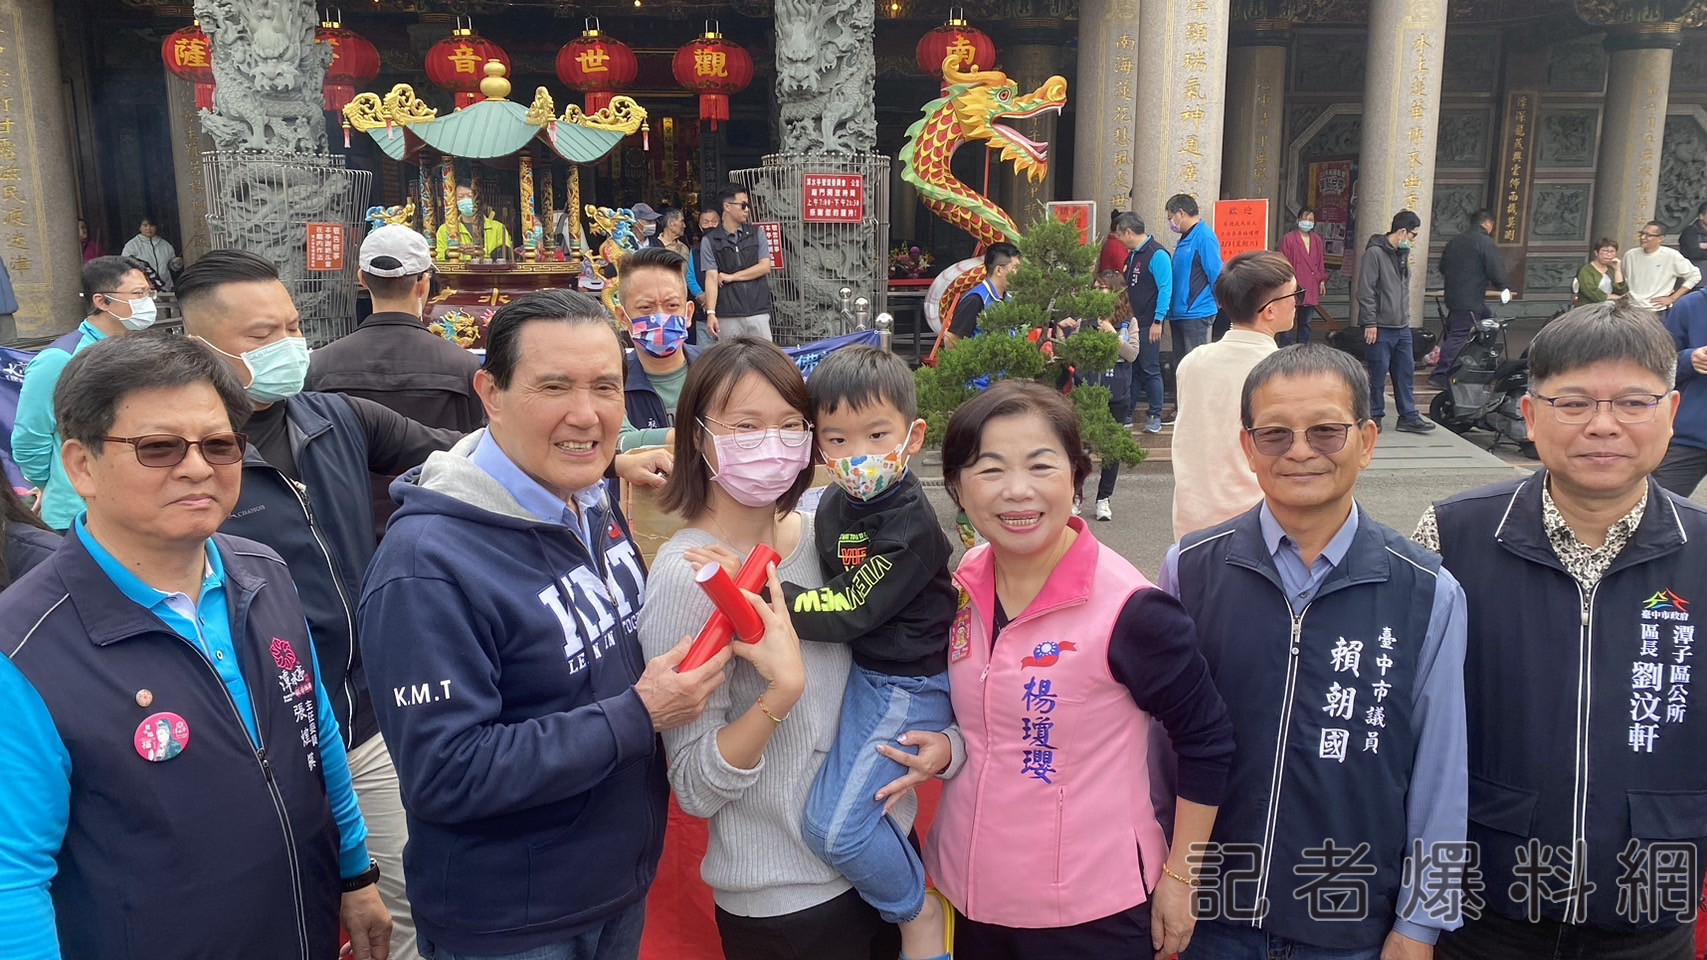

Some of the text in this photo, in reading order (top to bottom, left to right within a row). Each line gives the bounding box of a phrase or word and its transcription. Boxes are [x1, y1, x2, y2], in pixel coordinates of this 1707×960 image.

[175, 38, 210, 67] 薩
[448, 44, 482, 74] 音
[575, 46, 610, 73] 世
[693, 48, 728, 78] 觀
[946, 35, 976, 65] 南
[1641, 609, 1689, 621] 臺中市政府
[567, 642, 602, 675] LEN
[1666, 624, 1695, 723] 潭子區公所
[1319, 636, 1364, 764] 賴朝國
[1362, 626, 1398, 755] 臺中市議員
[1628, 623, 1664, 753] 區長 劉汶軒
[1020, 676, 1058, 784] 楊瓊瓔
